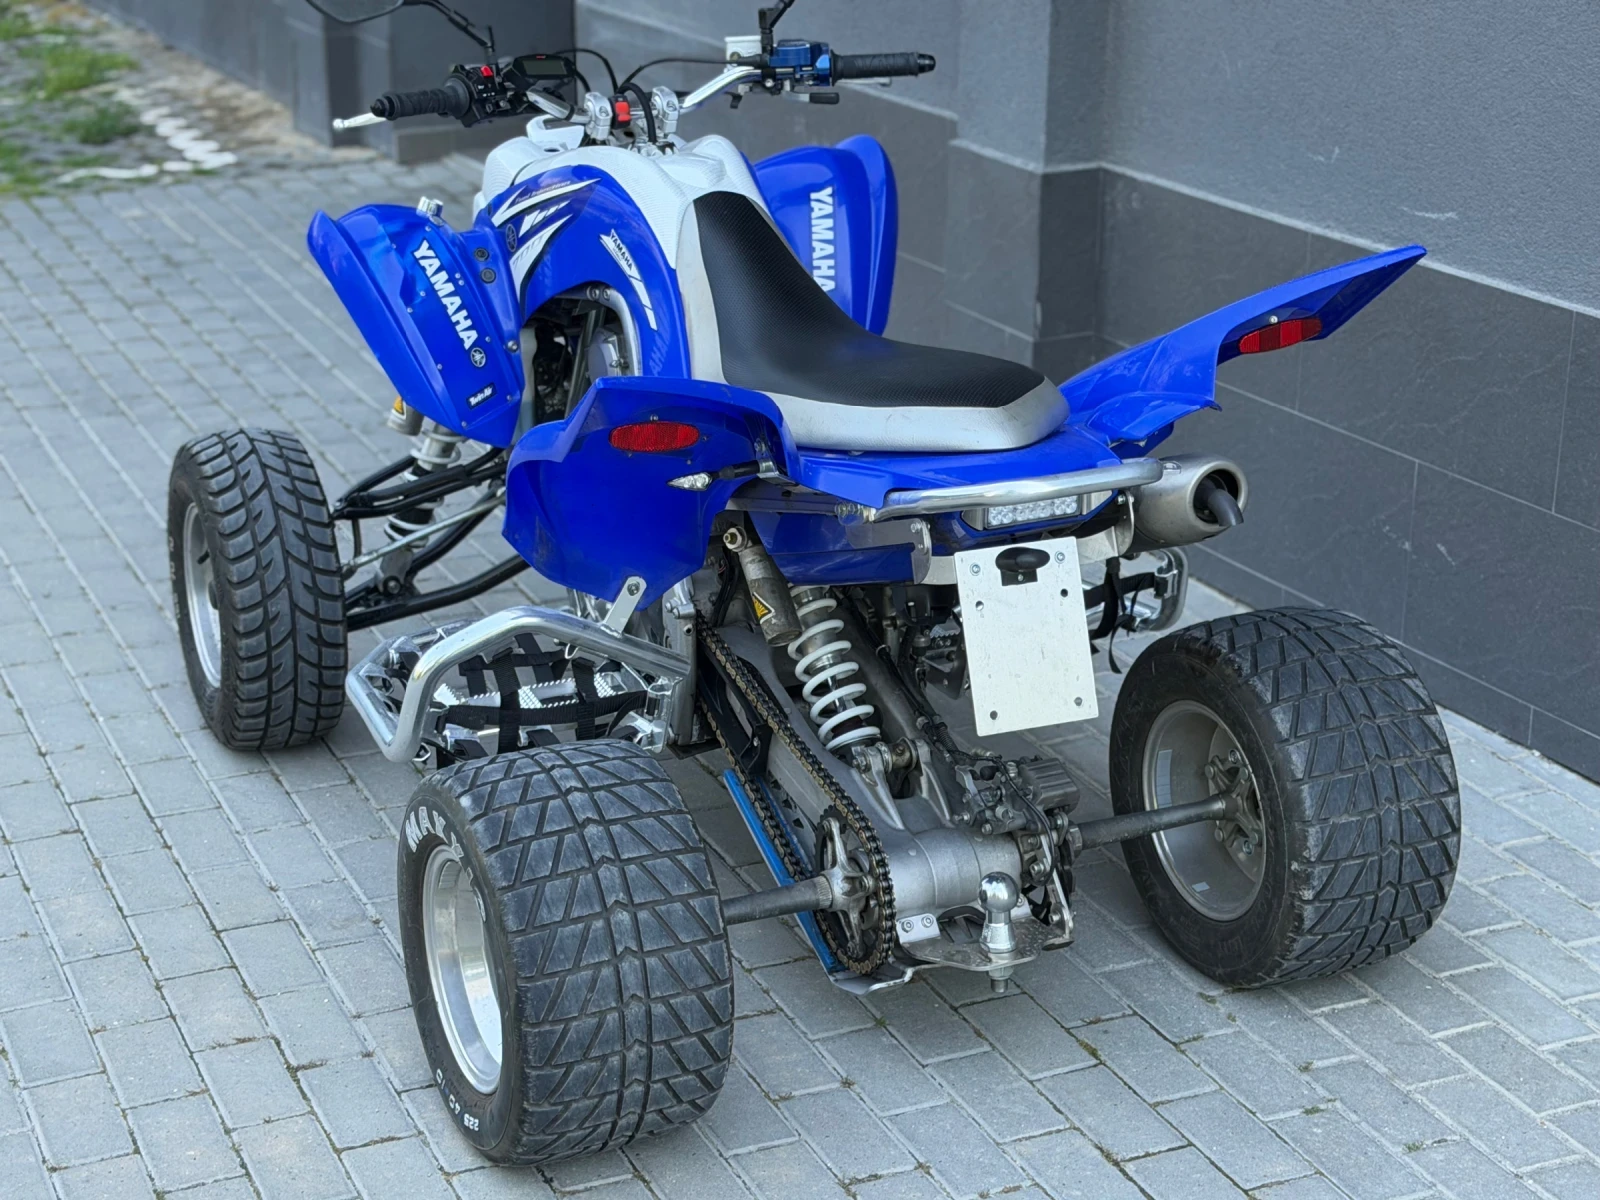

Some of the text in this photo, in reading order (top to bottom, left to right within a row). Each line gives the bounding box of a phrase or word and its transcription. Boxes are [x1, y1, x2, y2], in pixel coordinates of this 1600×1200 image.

[610, 232, 633, 271] YAMAHA
[810, 186, 836, 293] YAMAHA
[413, 239, 478, 350] YAMAHA
